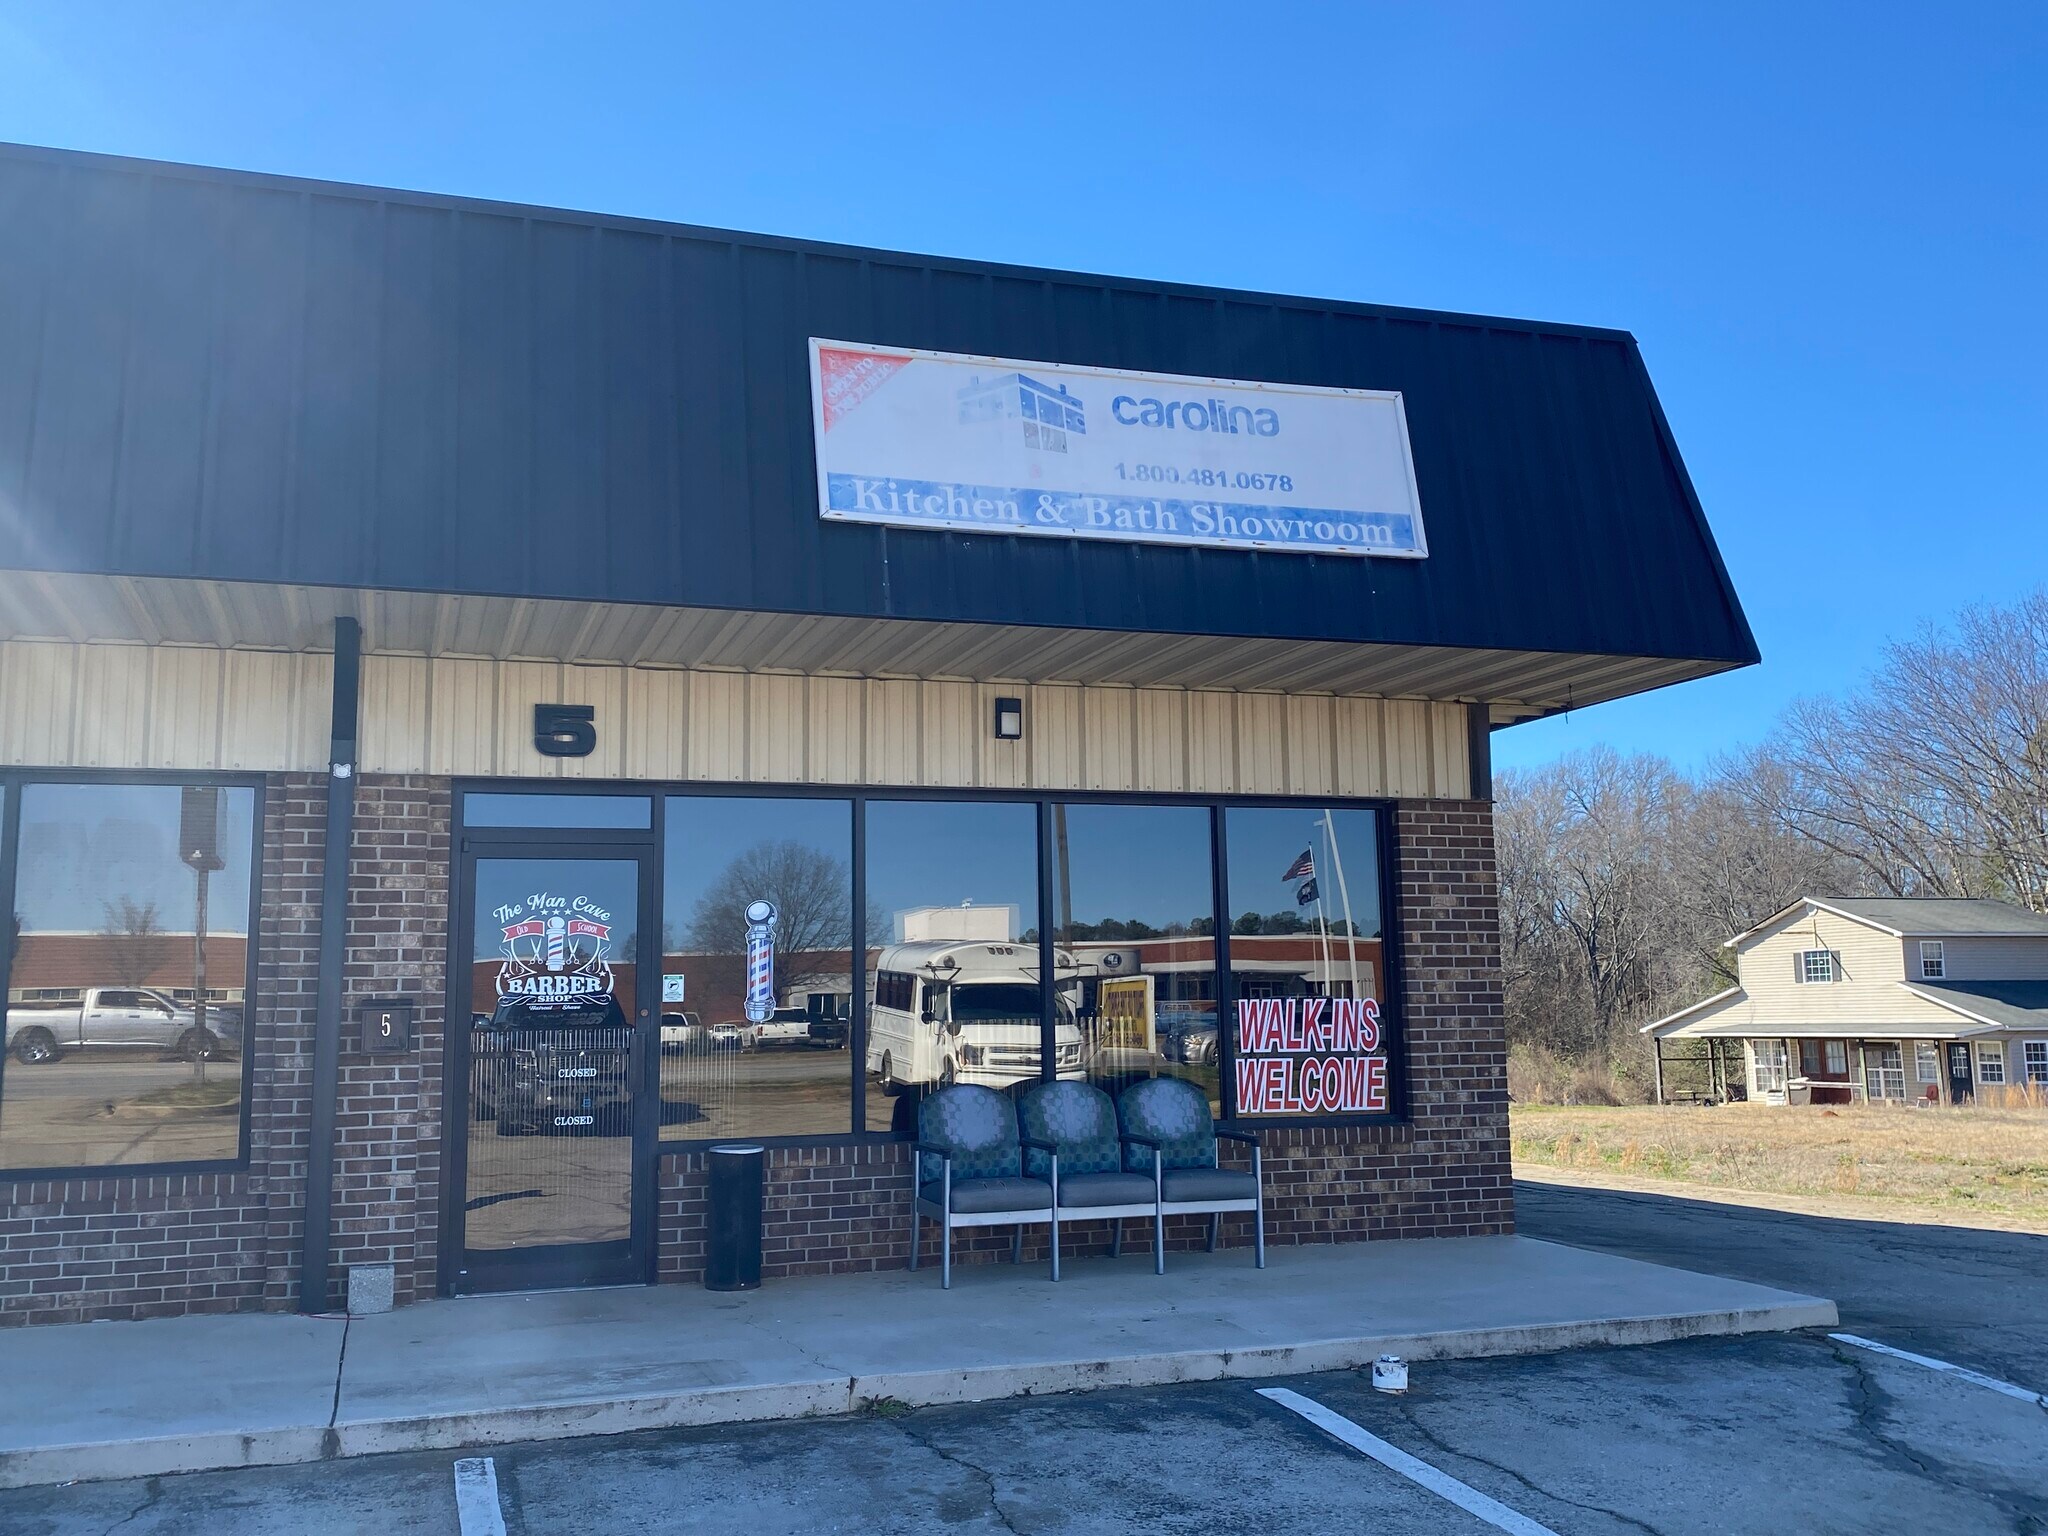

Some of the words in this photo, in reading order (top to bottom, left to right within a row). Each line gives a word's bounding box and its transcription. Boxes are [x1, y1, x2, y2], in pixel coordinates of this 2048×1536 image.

[1111, 395, 1280, 437] carolina
[1114, 462, 1294, 492] 1.800.481.0678
[852, 479, 1021, 521] Kitchen
[1035, 494, 1069, 524] &
[1083, 497, 1178, 531] Bath
[1190, 504, 1396, 545] Showroom
[535, 704, 597, 757] 5
[492, 904, 523, 924] The
[527, 891, 567, 911] Man
[572, 895, 611, 921] Cave
[516, 925, 529, 936] OLD
[576, 922, 598, 934] SCHOOL
[507, 976, 603, 996] BARBER
[537, 995, 573, 1003] SHOP
[381, 1014, 391, 1037] 5
[1238, 998, 1380, 1052] WALK-INS
[558, 1068, 597, 1078] CLOSED
[1235, 1057, 1387, 1113] WELCOME
[554, 1115, 593, 1126] CLOSED
